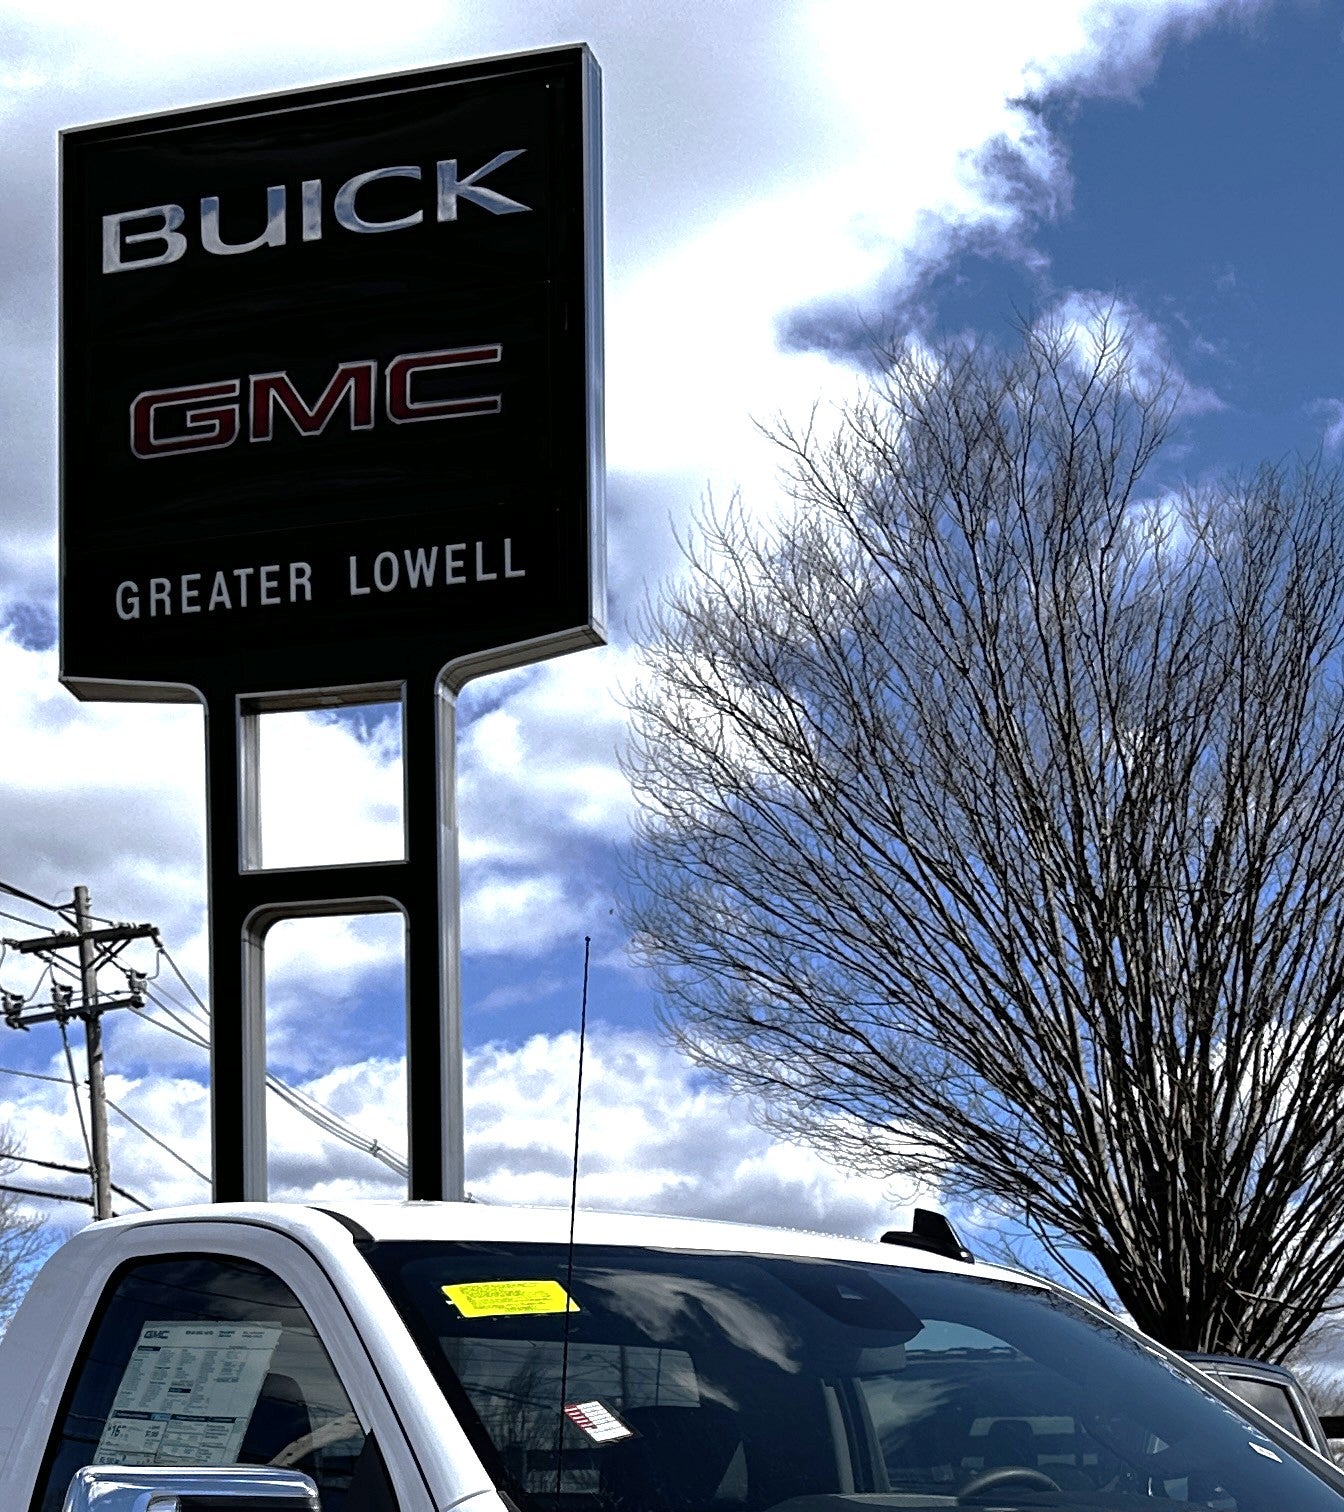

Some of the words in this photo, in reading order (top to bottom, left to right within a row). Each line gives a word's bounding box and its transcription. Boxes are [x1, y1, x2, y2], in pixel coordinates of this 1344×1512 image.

[103, 149, 533, 274] BUICK
[129, 343, 502, 460] GMC
[115, 561, 313, 620] GREATER
[349, 538, 526, 597] LOWELL
